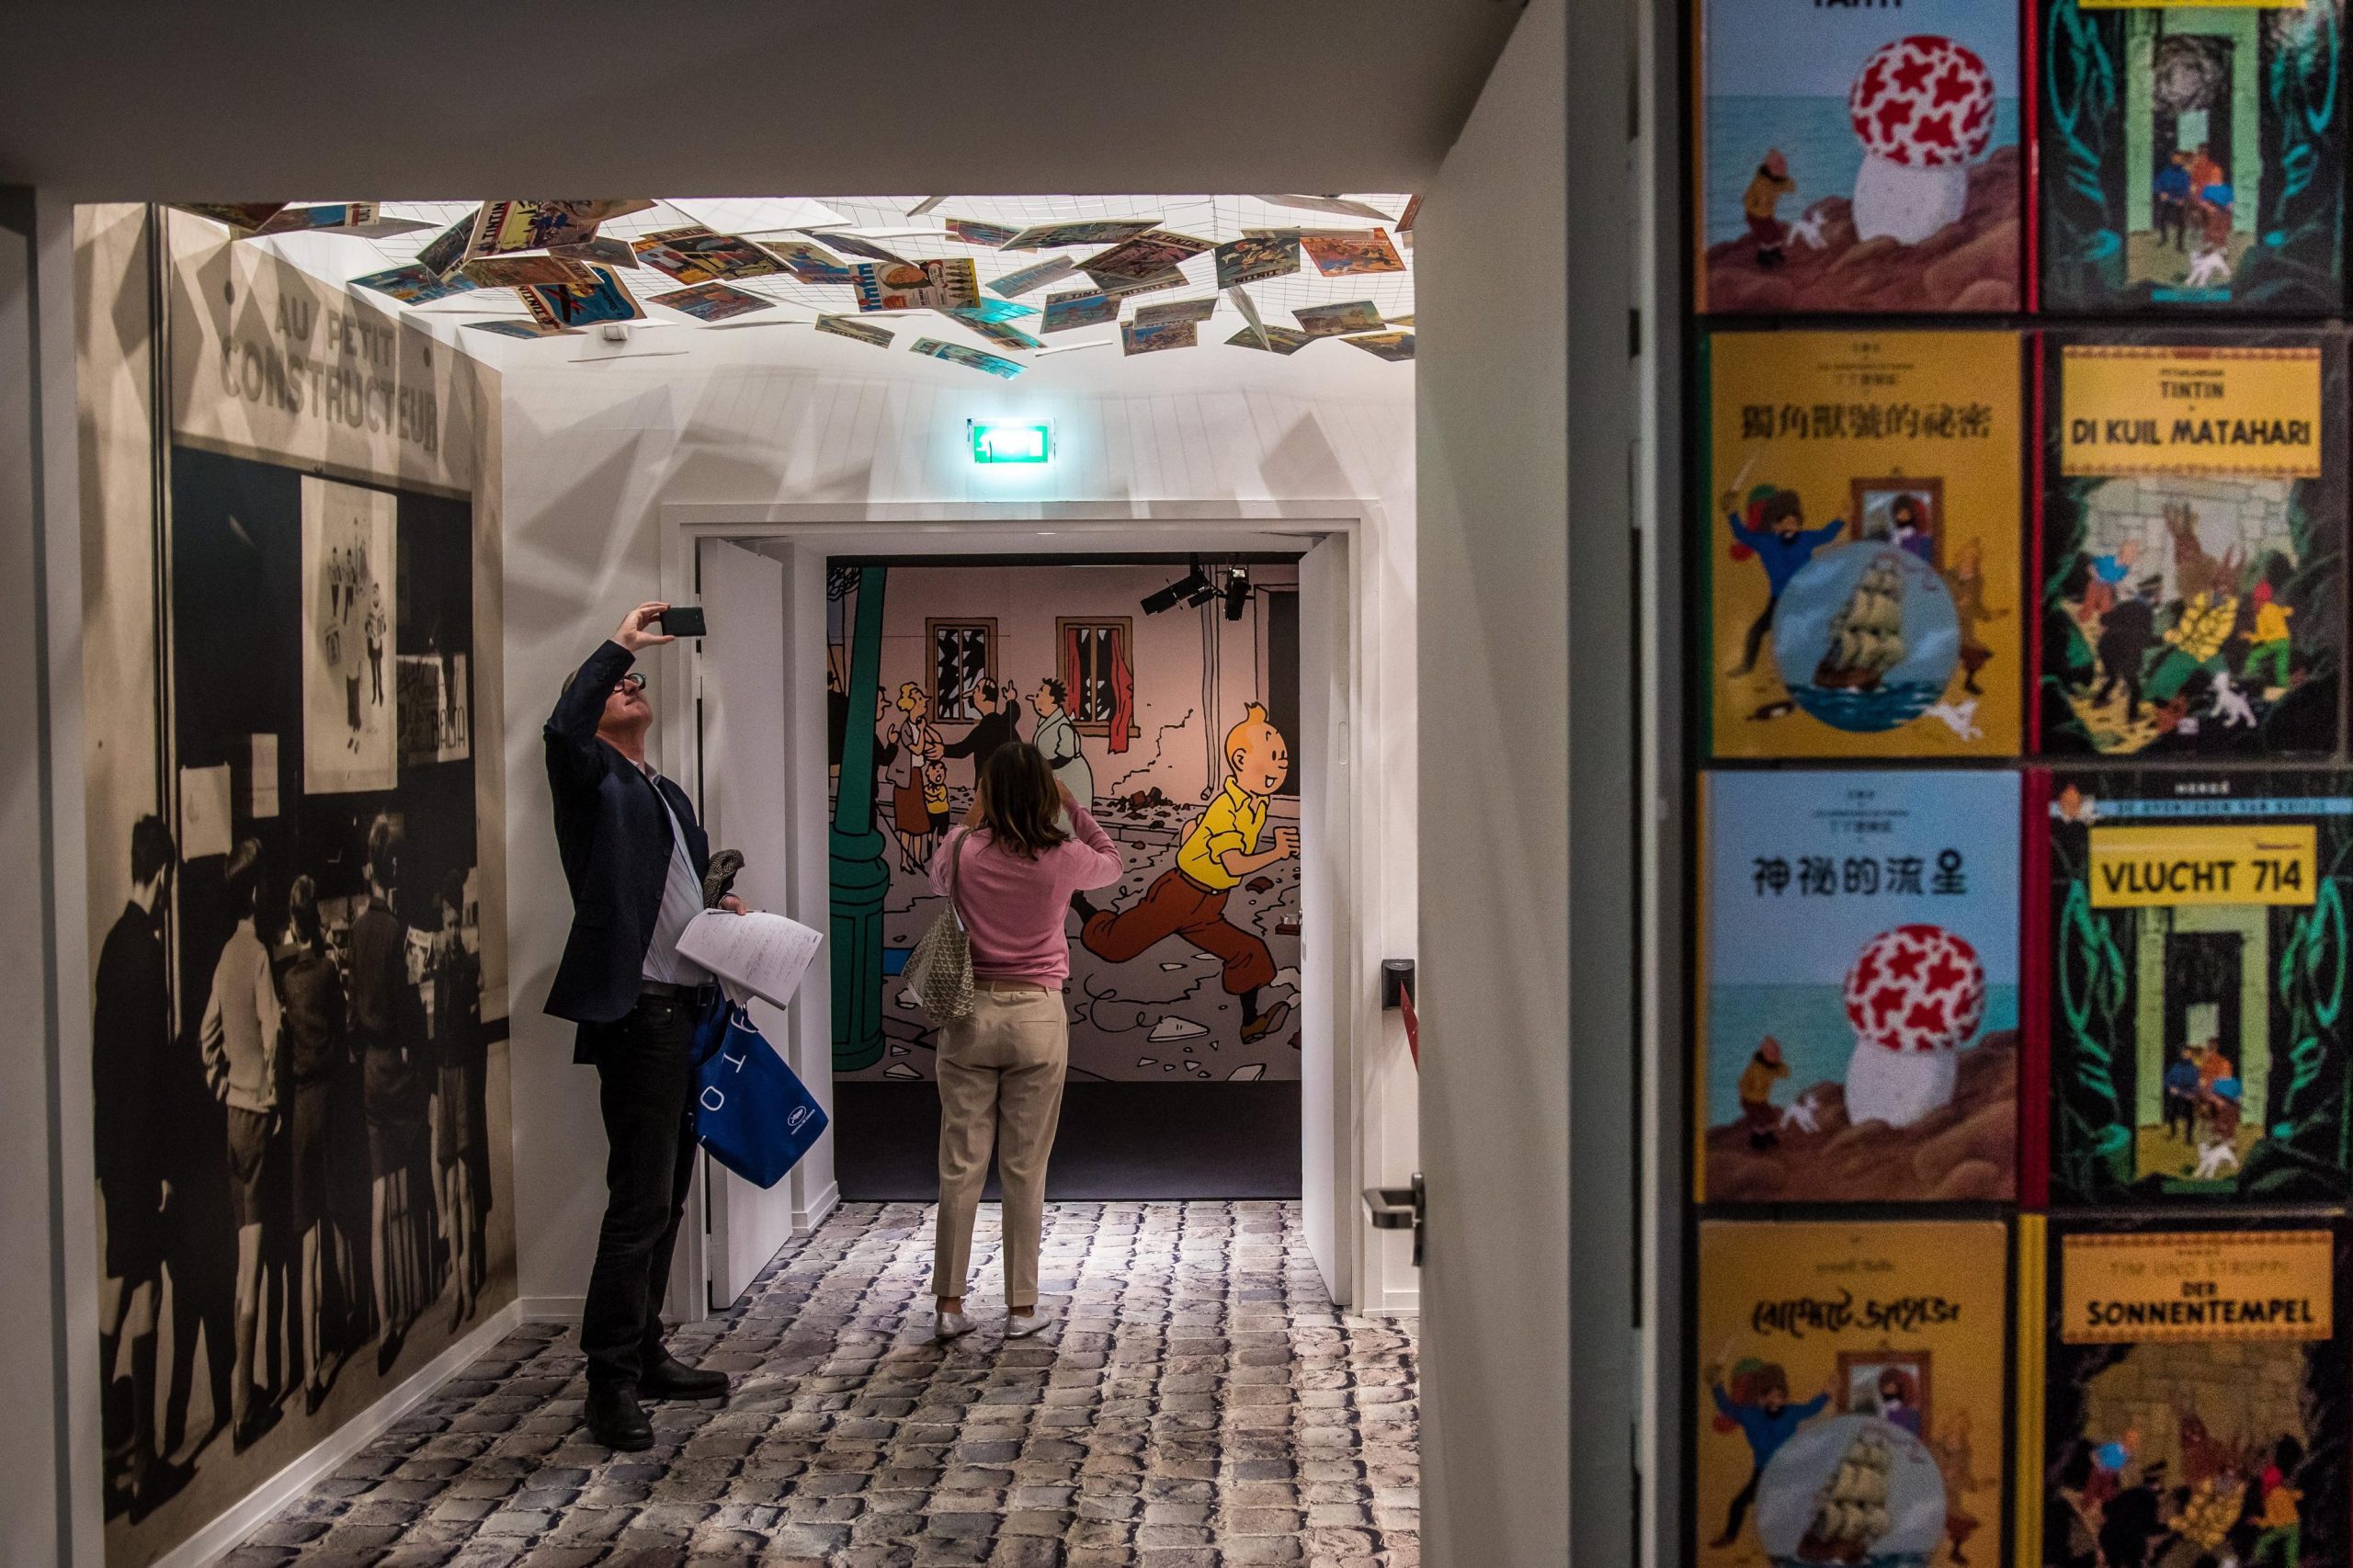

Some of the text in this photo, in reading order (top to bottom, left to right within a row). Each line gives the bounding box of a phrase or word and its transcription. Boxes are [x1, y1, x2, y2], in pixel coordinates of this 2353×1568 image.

[482, 201, 506, 241] TINTIN
[1163, 235, 1204, 247] TINTIN
[1234, 270, 1279, 284] TINTIN
[1120, 284, 1165, 296] TINTIN
[275, 292, 395, 367] AU PETIT
[221, 335, 438, 454] CONSTRUCTEUR
[2161, 381, 2224, 399] TINTIN
[2072, 419, 2311, 445] DI KUIL MATAHARI
[2100, 859, 2302, 892] VLUCHT 714
[2180, 1282, 2217, 1297] DER
[2087, 1300, 2313, 1324] SONNENTEMPEL
